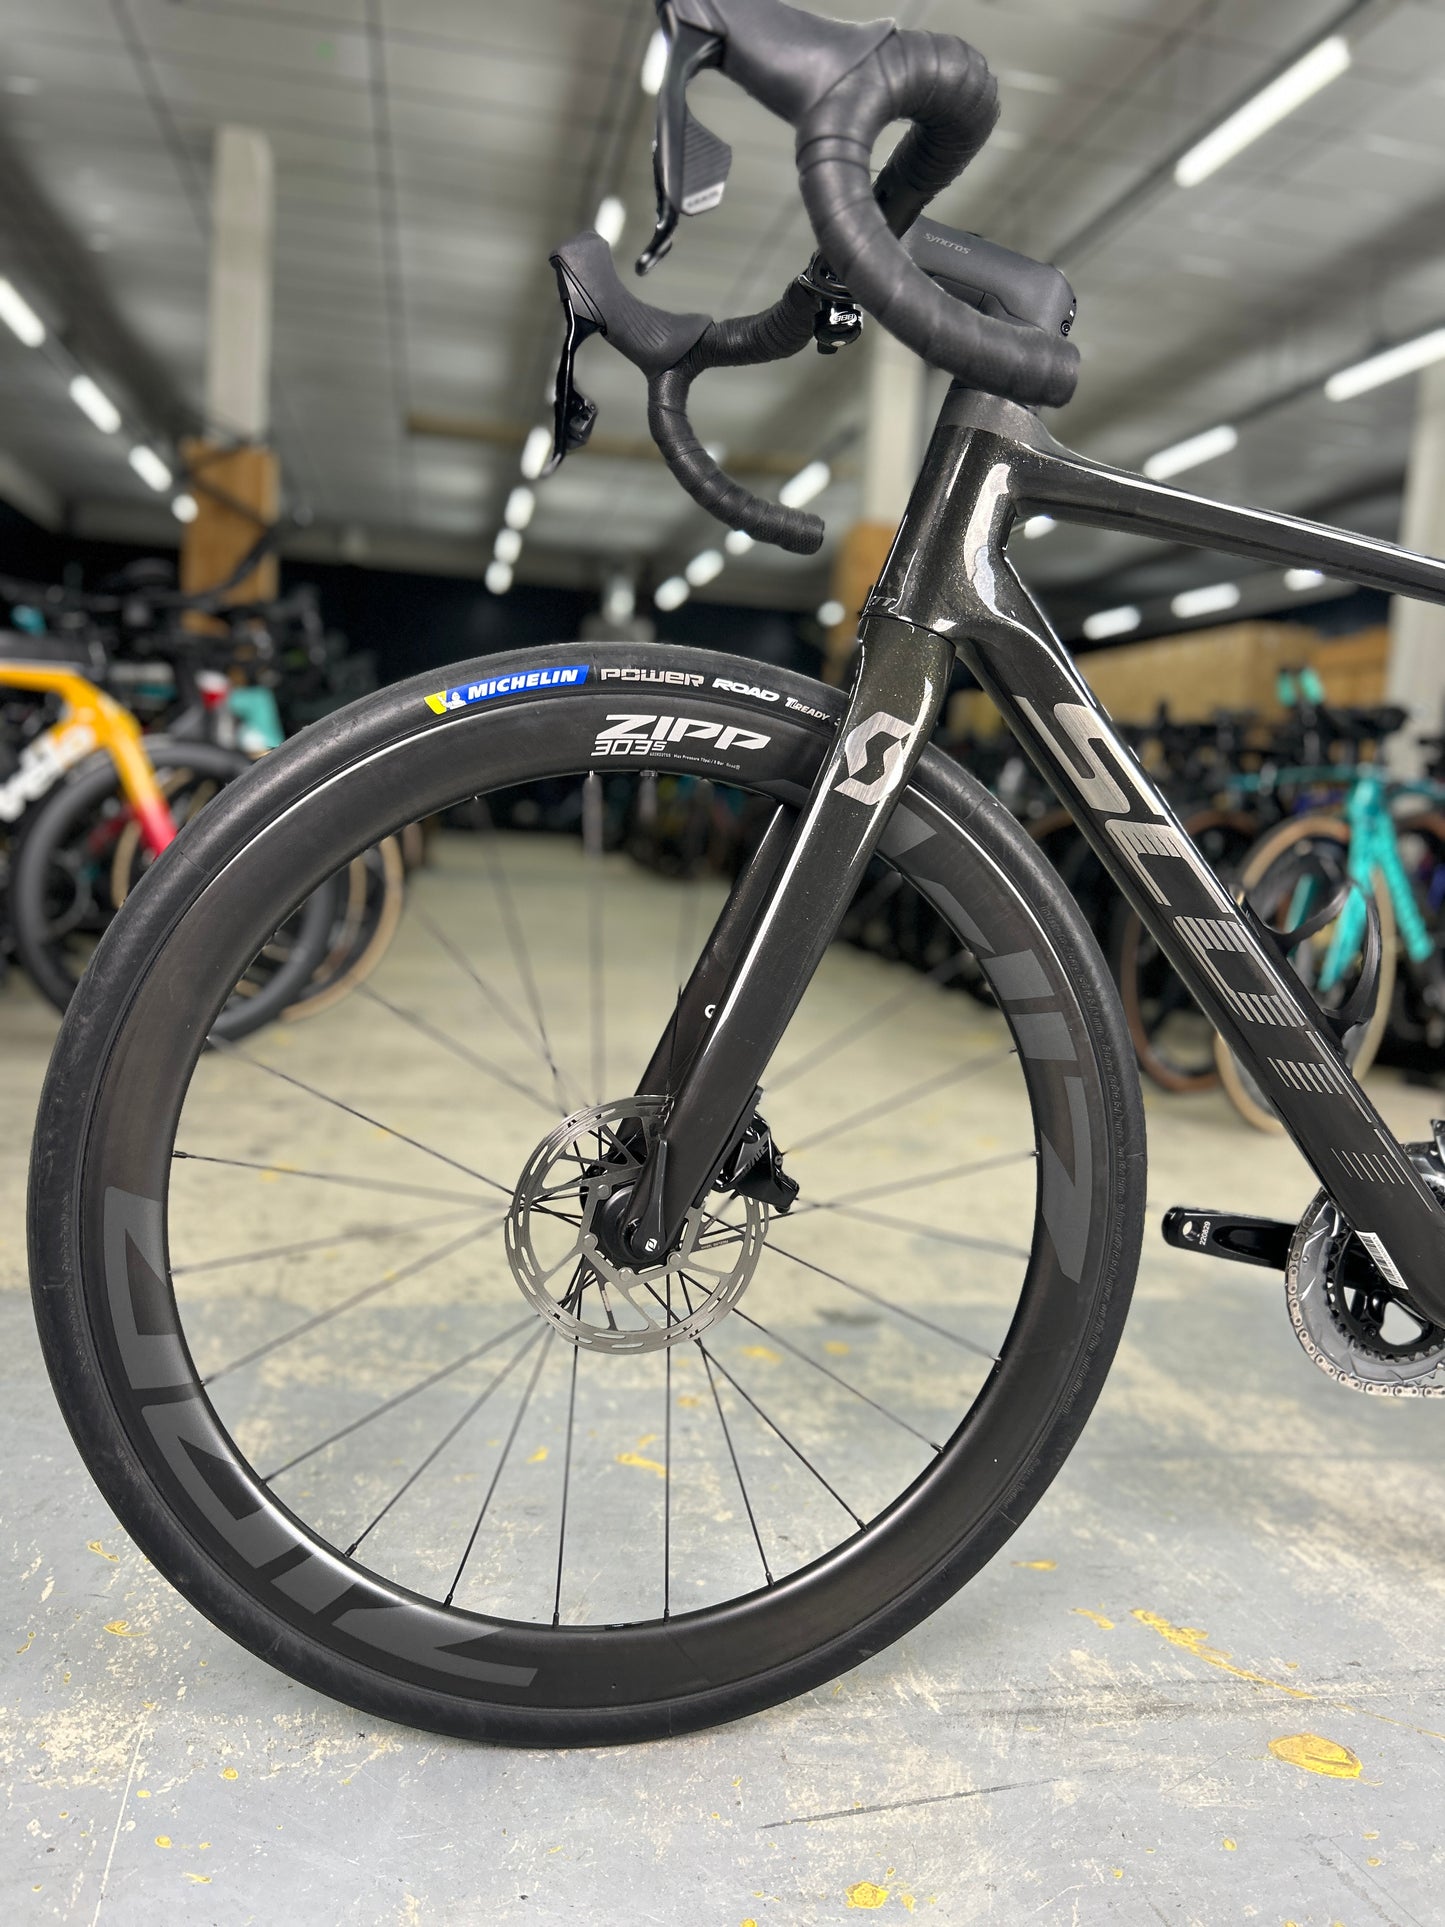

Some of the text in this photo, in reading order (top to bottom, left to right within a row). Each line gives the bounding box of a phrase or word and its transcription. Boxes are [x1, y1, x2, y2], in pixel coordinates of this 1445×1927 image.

[924, 233, 972, 254] syncros
[467, 669, 579, 700] MICHELIN
[601, 668, 704, 687] POWER
[712, 678, 780, 702] ROAD
[595, 713, 772, 750] ZIPP
[103, 1186, 539, 1688] ZIPP
